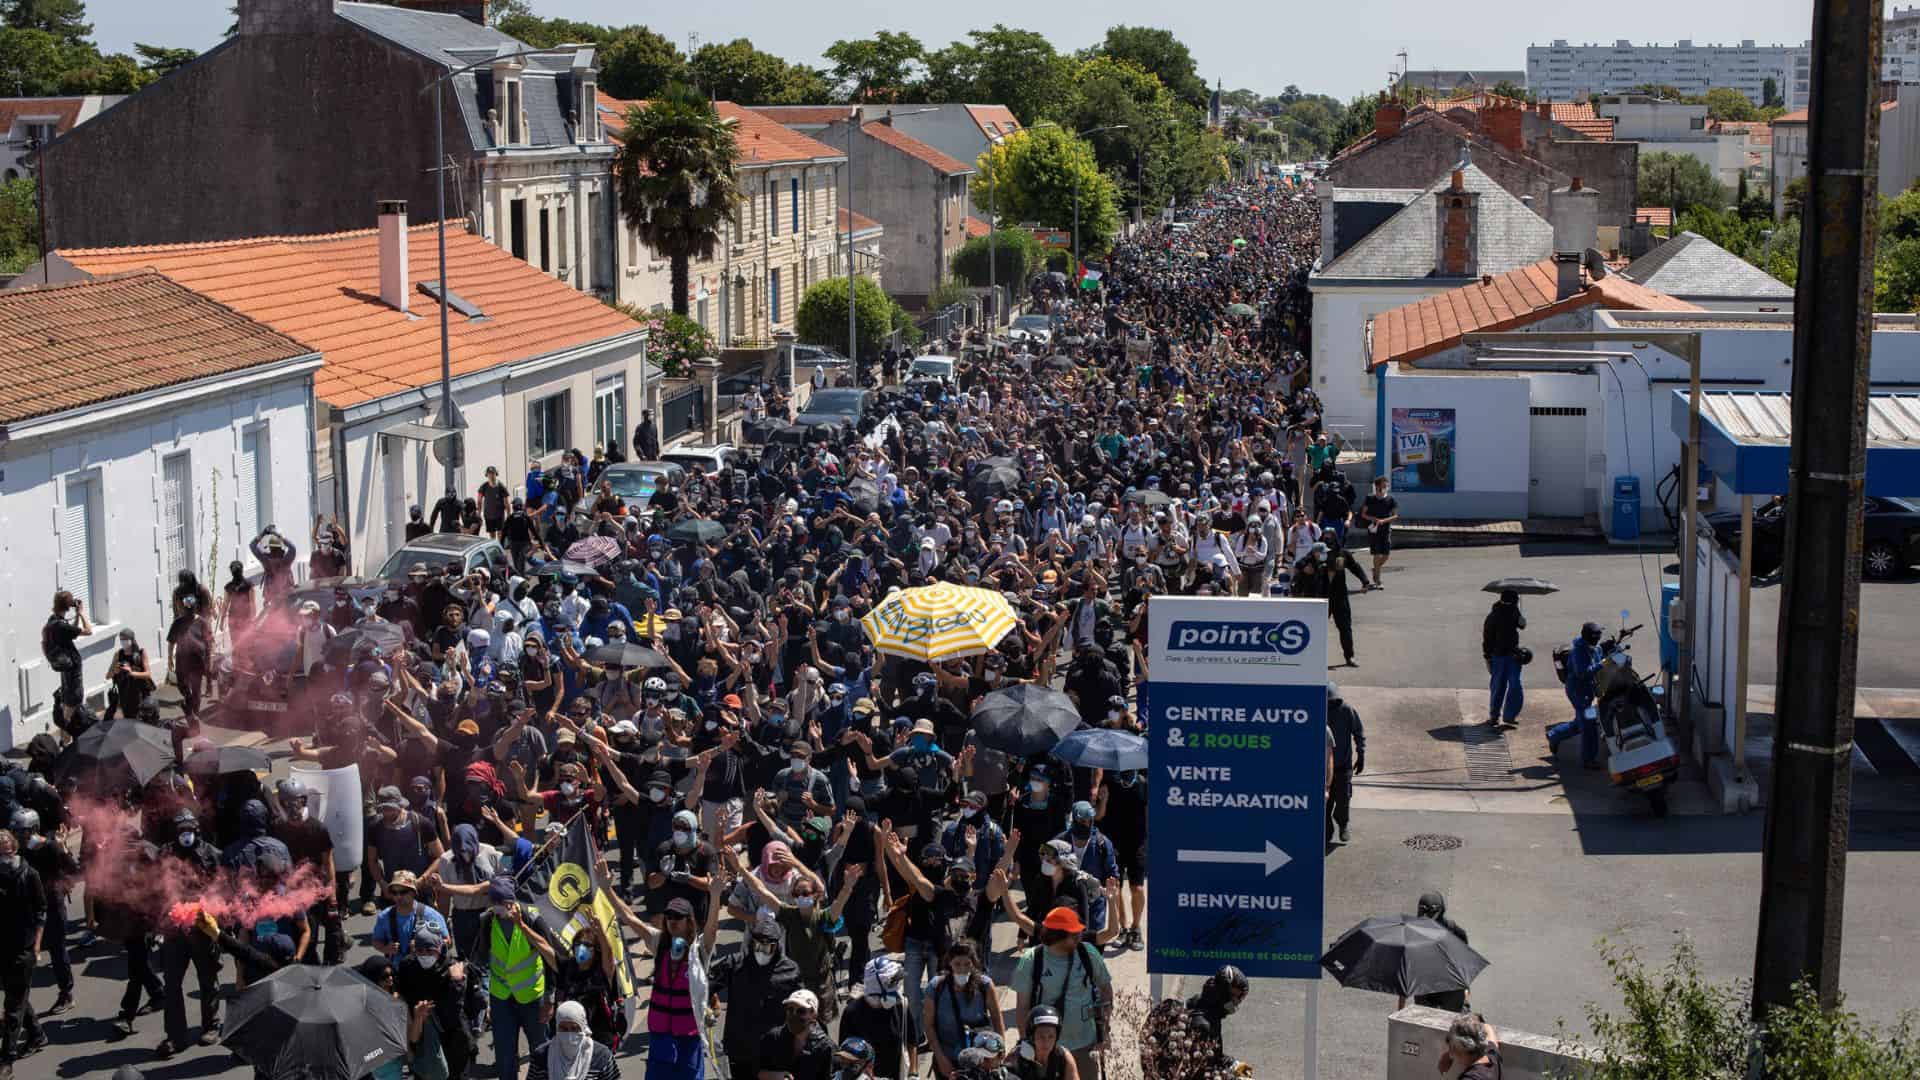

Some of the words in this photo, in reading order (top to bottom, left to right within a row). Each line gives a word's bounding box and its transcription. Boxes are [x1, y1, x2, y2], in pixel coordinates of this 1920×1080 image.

[1400, 434, 1426, 448] TVA
[1178, 625, 1262, 647] point
[1279, 625, 1304, 649] S
[1165, 706, 1246, 722] CENTRE
[1251, 708, 1309, 723] AUTO
[1166, 727, 1185, 747] &
[1188, 733, 1200, 748] 2
[1204, 734, 1271, 749] ROUES
[1167, 766, 1232, 781] VENTE
[1166, 786, 1185, 806] &
[1188, 788, 1308, 809] RÉPARATION
[1177, 893, 1292, 910] BIENVENUE
